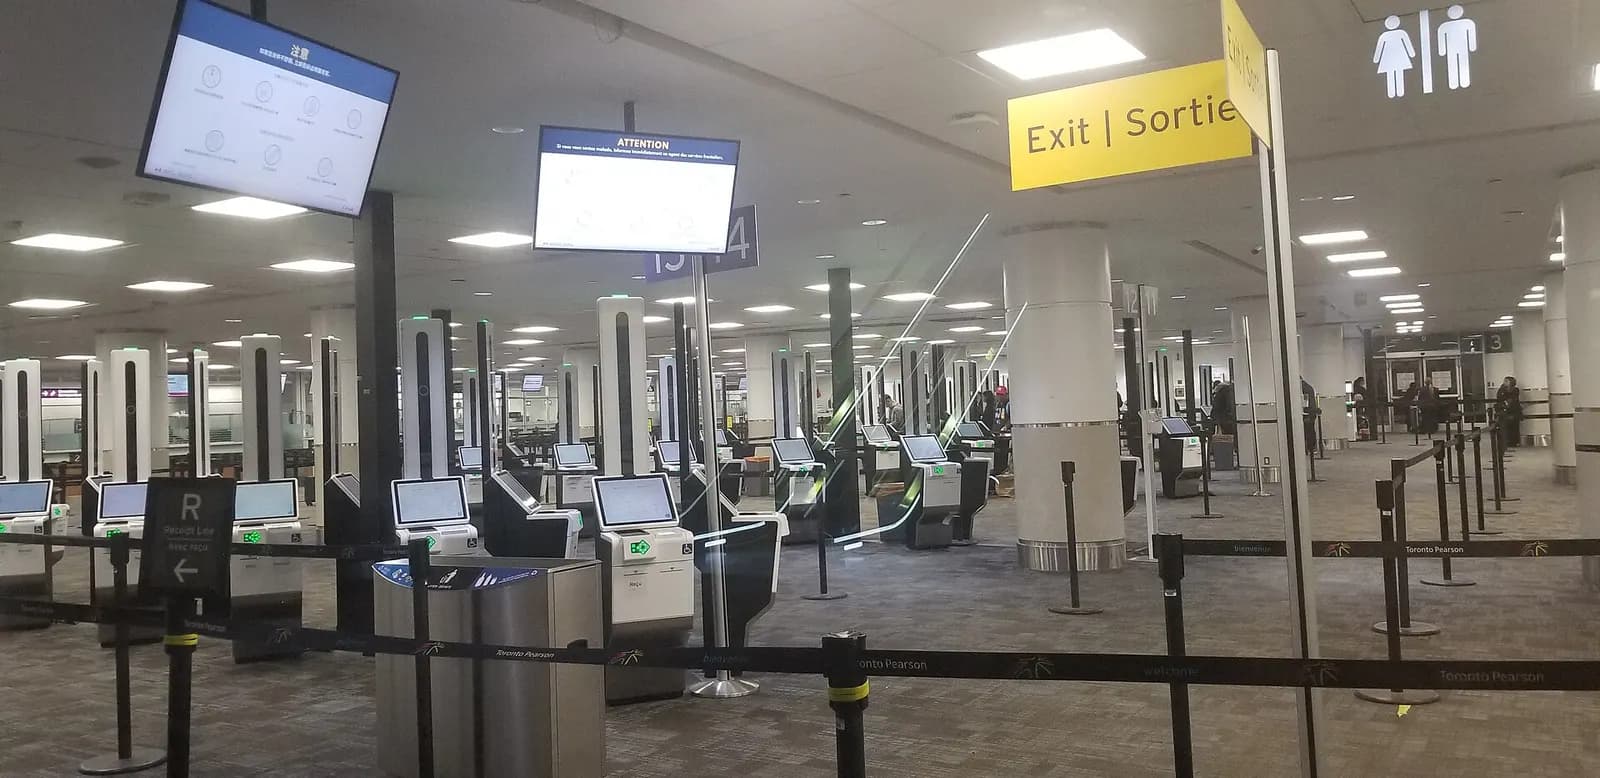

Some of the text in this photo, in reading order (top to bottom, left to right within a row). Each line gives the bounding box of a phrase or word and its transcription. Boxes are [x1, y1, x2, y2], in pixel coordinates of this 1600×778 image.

[1027, 119, 1090, 154] Exit
[1126, 95, 1236, 138] Sortie
[617, 136, 669, 150] ATTENTION
[1490, 334, 1503, 350] 3
[181, 493, 202, 520] R
[1405, 545, 1465, 553] Toronto Pearson
[496, 649, 556, 659] Toronto Pearson
[885, 659, 928, 670] Pearson
